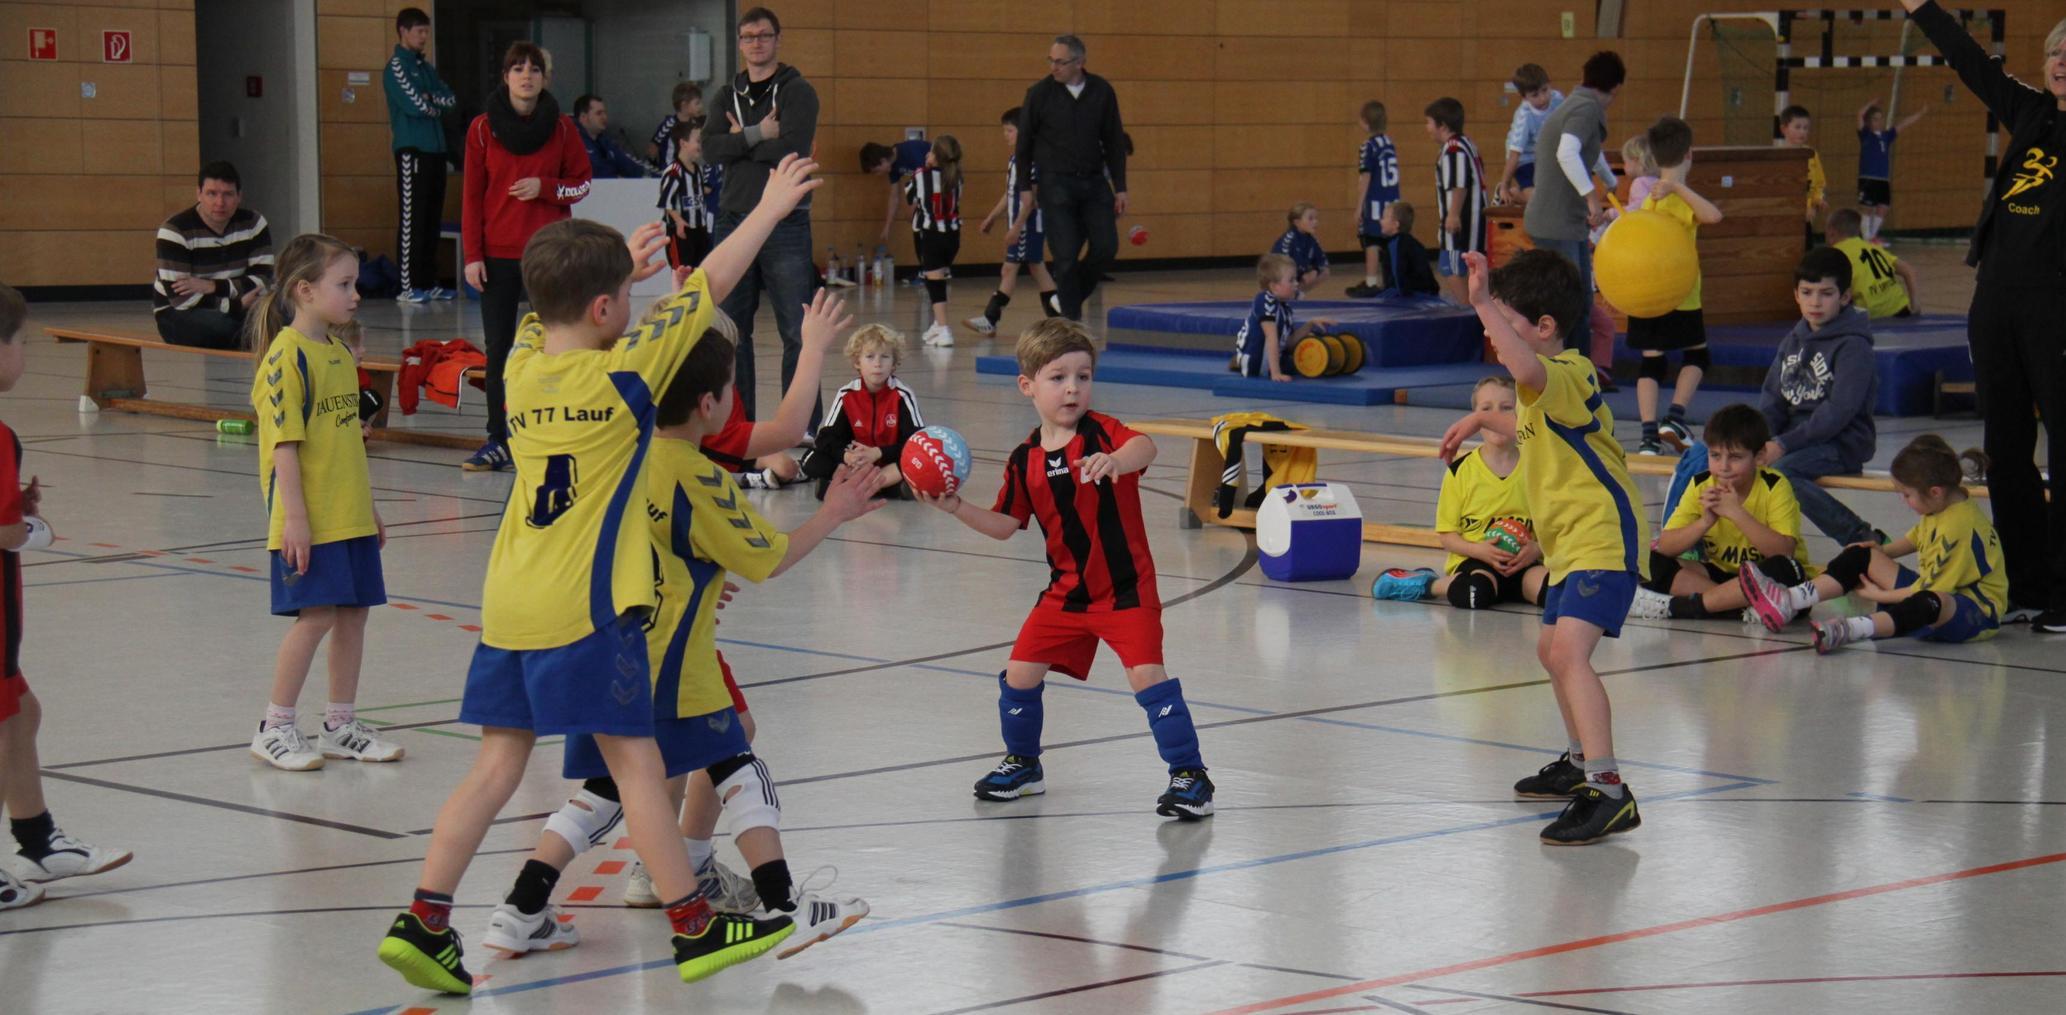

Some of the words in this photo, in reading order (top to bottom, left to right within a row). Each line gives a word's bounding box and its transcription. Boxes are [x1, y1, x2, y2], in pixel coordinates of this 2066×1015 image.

[1379, 157, 1398, 187] 15
[2008, 202, 2040, 215] Coach
[1860, 248, 1893, 279] 10
[509, 413, 526, 433] TV
[532, 407, 555, 425] 77
[564, 406, 614, 422] Lauf
[1047, 467, 1069, 478] erima
